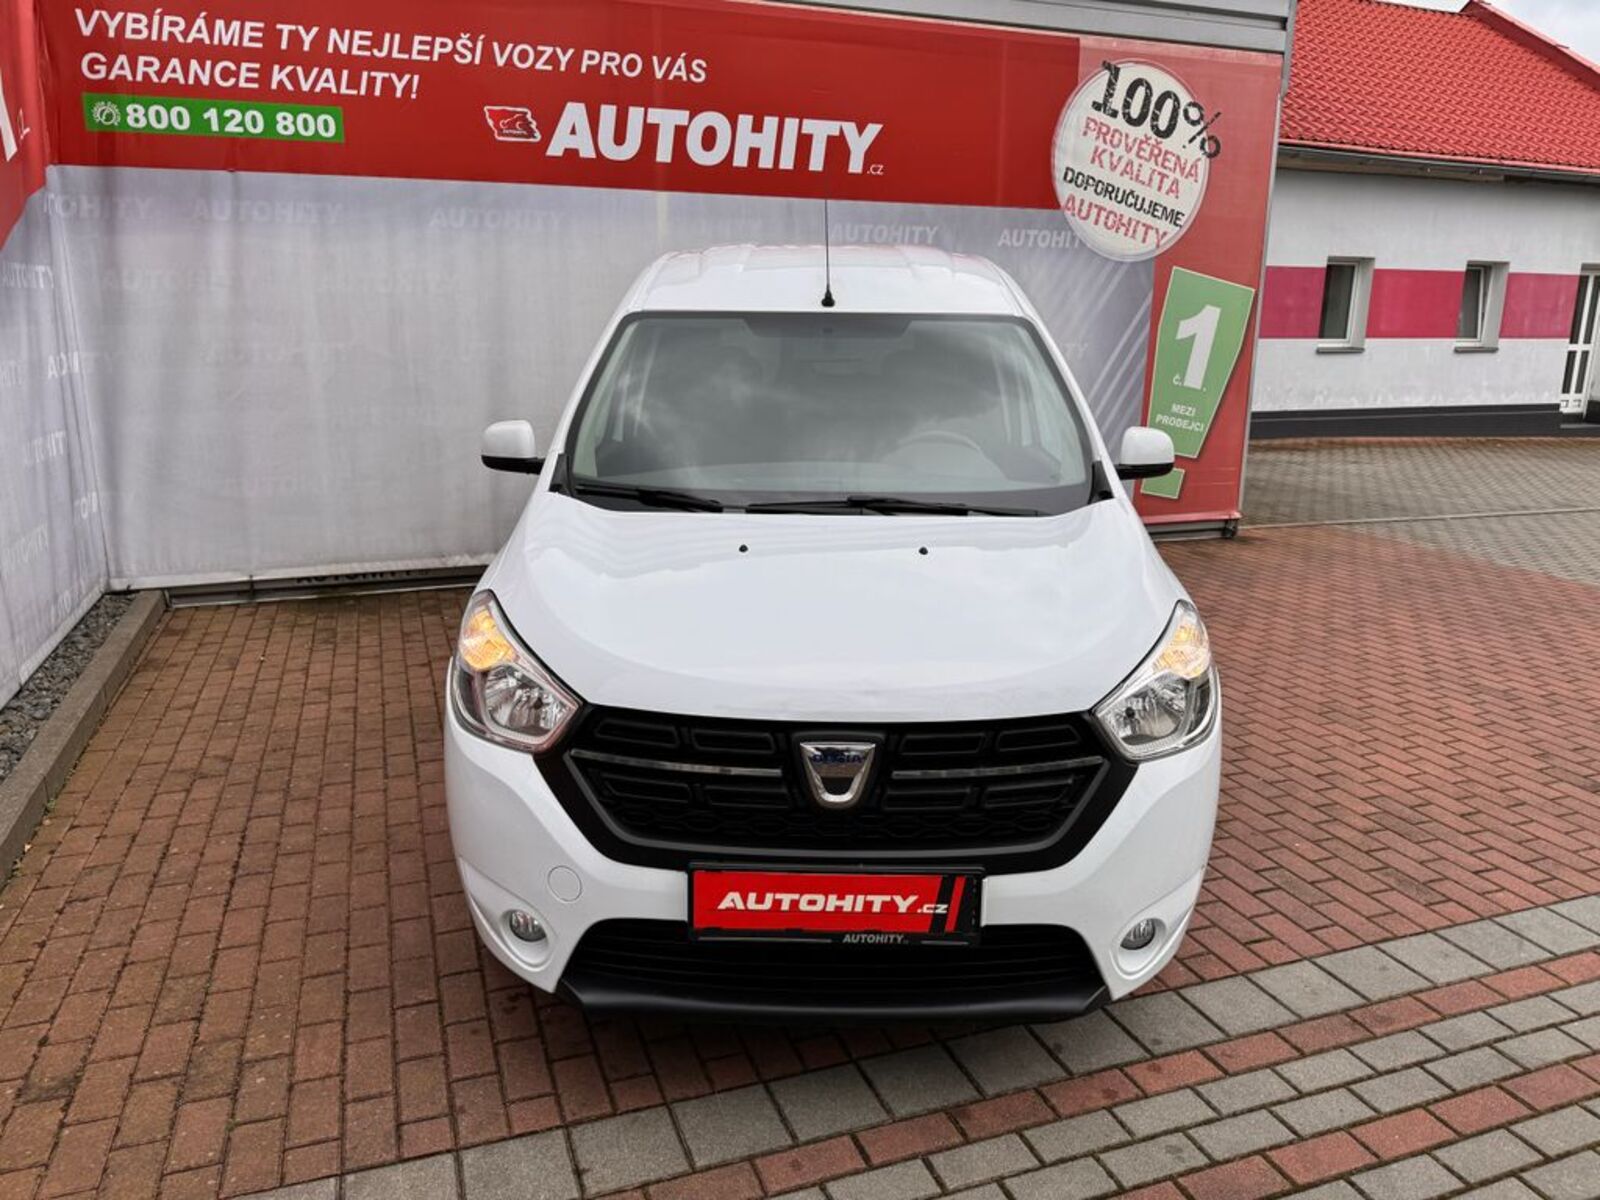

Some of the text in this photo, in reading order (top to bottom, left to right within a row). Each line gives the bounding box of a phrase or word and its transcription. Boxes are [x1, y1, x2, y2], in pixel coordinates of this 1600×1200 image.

[75, 8, 708, 83] VYBÍRÁME TY NEJLEPŠÍ VOZY PRO VÁS
[80, 52, 421, 100] GARANCE KVALITY!
[126, 103, 191, 131] 800
[203, 107, 265, 135] 120
[275, 111, 337, 138] 800
[1091, 60, 1222, 159] 100%
[1063, 166, 1187, 229] DOPORUČUJEME
[1090, 148, 1181, 200] KVALITA
[831, 222, 939, 246] AUTOHITY
[1062, 194, 1169, 250] AUTOHITY
[1171, 403, 1197, 417] MEZI
